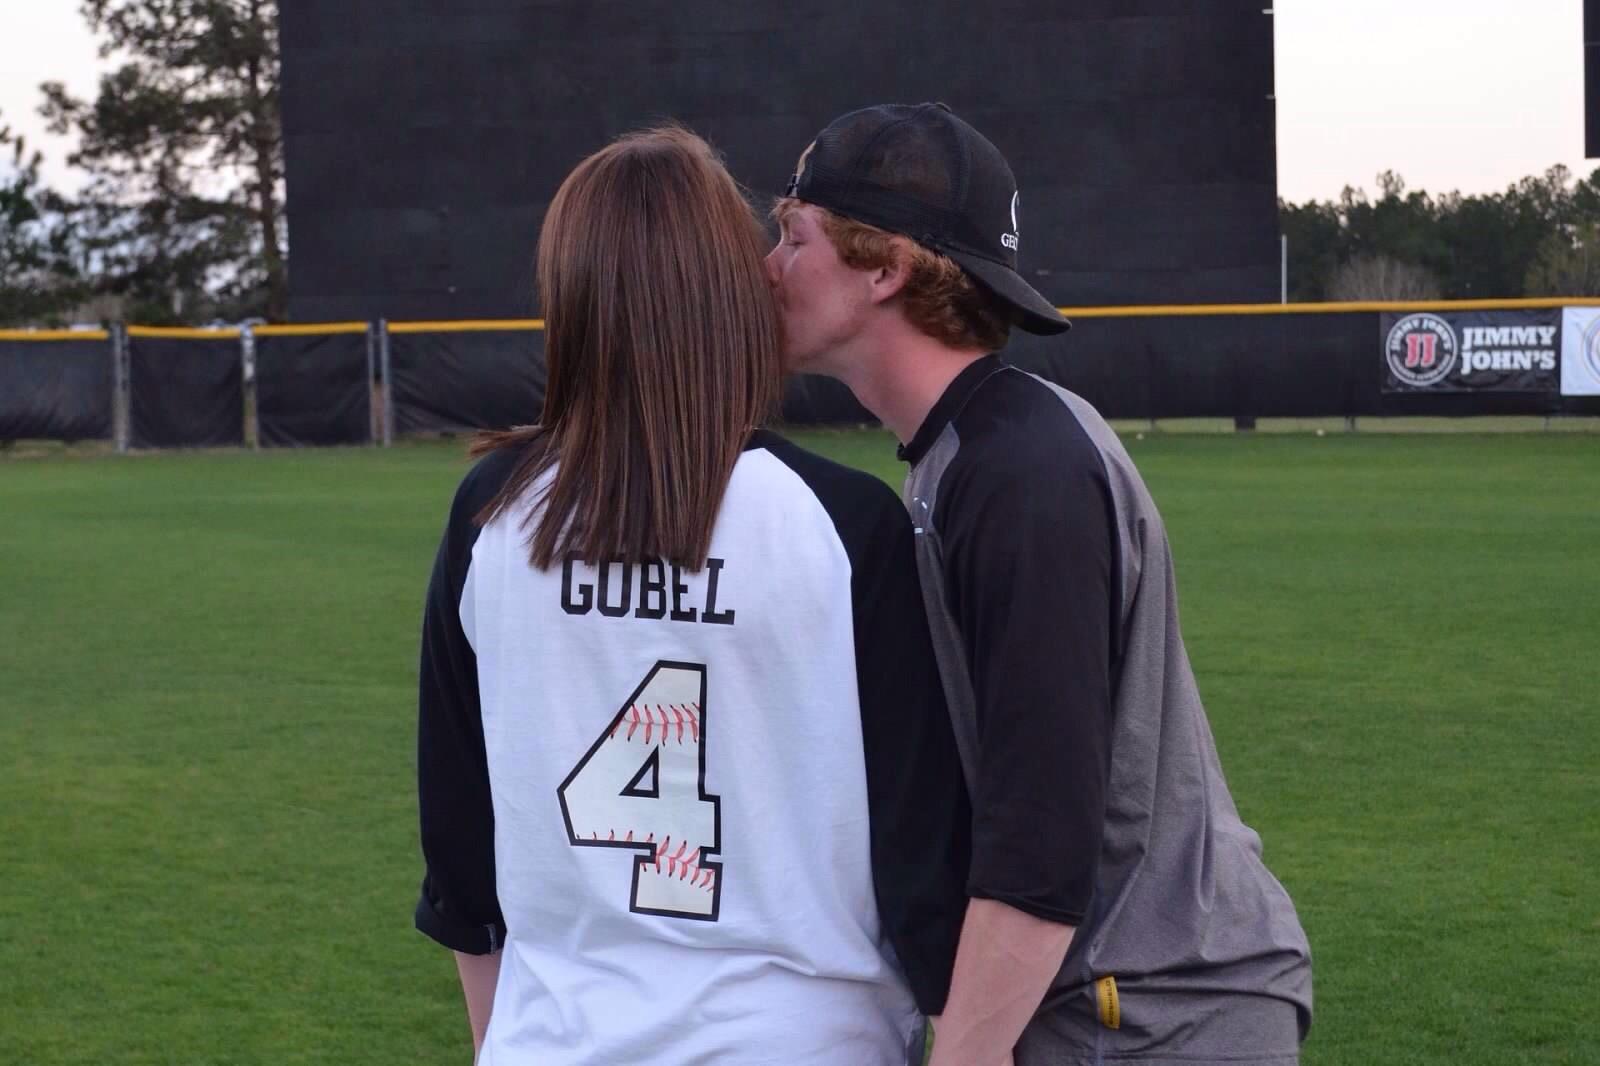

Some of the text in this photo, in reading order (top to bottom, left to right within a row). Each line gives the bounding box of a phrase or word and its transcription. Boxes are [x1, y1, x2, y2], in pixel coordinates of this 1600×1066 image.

[1405, 333, 1438, 368] JJ
[1462, 326, 1557, 350] JIMMY
[1461, 350, 1556, 375] JOHN'S
[561, 552, 735, 625] GOBEL
[557, 660, 723, 922] 4
